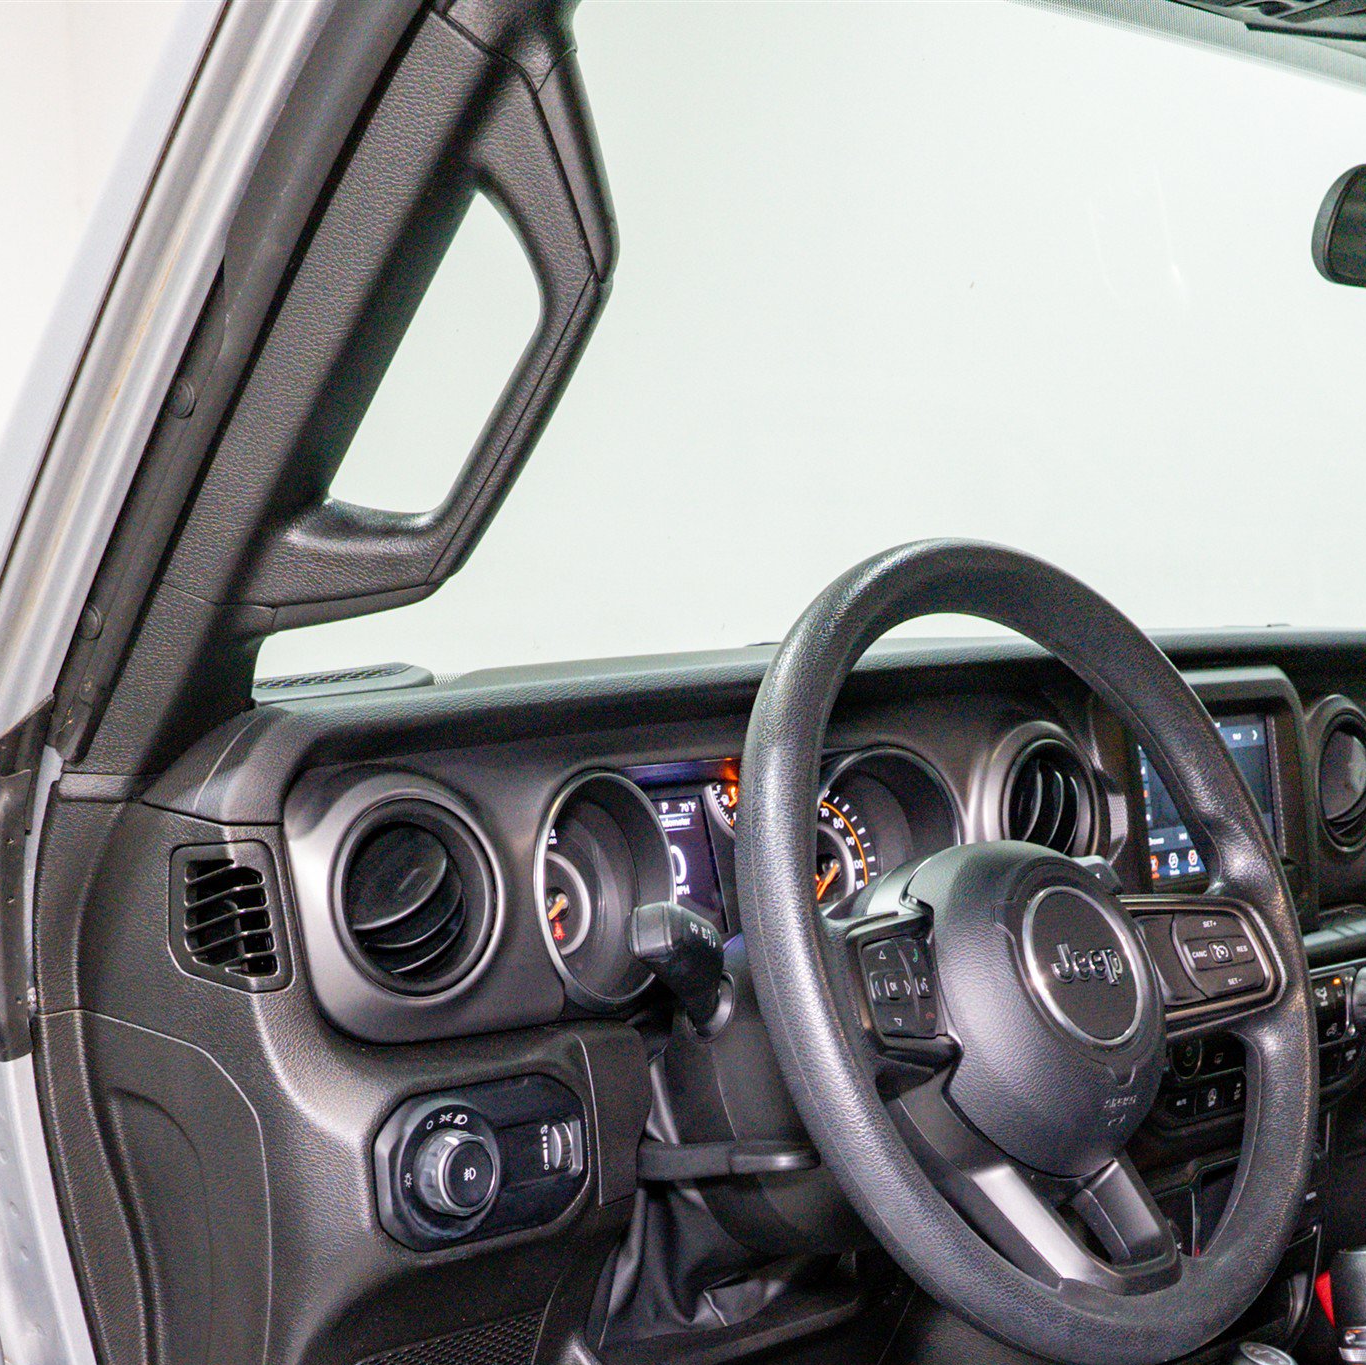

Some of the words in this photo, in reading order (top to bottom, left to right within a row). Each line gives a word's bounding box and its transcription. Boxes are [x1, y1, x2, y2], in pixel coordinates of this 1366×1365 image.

[661, 802, 669, 813] P
[820, 808, 829, 817] 70
[833, 818, 844, 829] 80
[846, 837, 855, 846] 90
[1202, 920, 1217, 928] SET+
[1236, 945, 1248, 953] RES
[1191, 950, 1208, 959] CANC
[1051, 943, 1123, 986] Jeep
